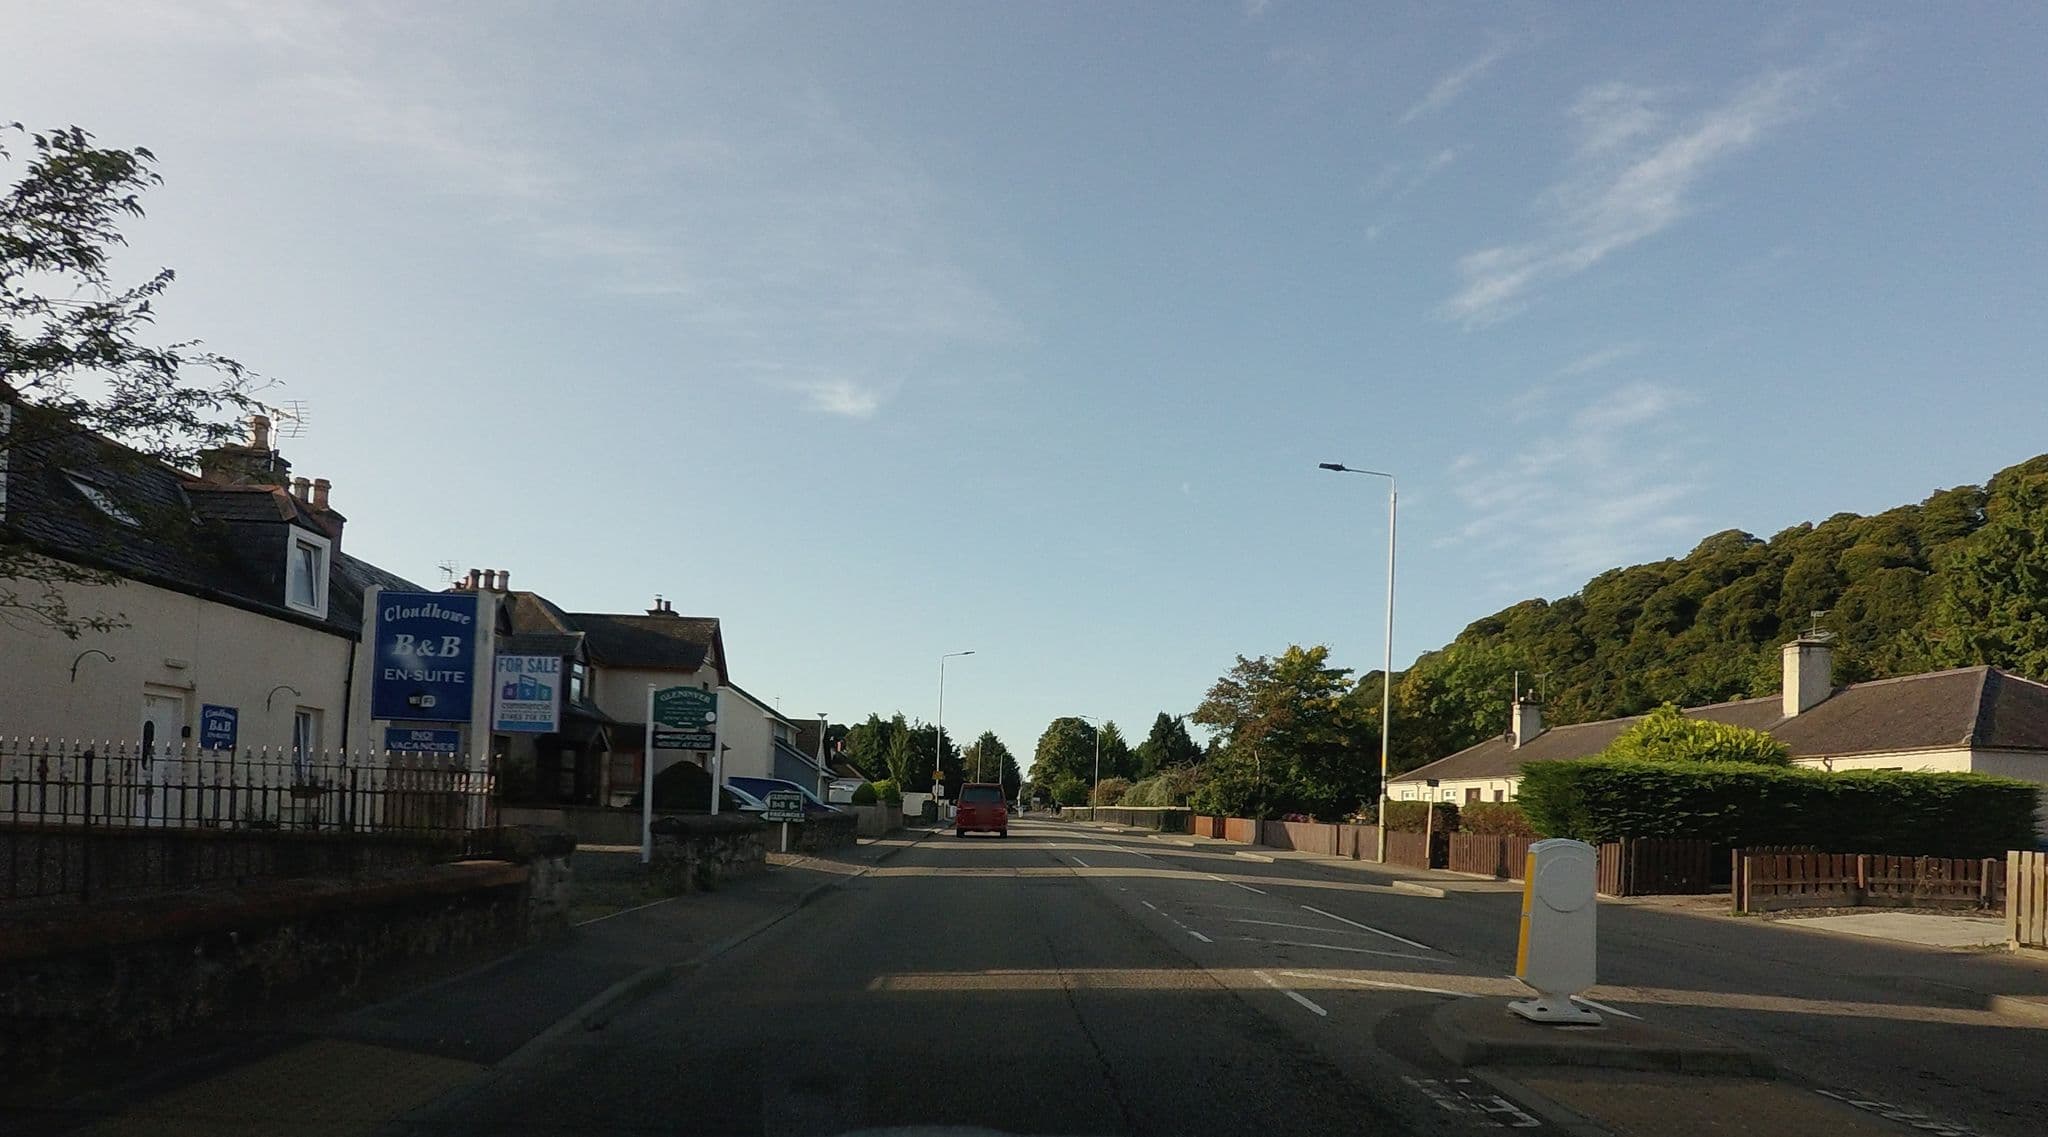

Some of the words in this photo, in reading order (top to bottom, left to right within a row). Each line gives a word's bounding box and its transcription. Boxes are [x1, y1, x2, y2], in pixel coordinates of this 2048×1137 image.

[384, 603, 472, 625] Cloudhowe
[498, 657, 523, 673] FOR
[527, 657, 560, 674] SALE
[384, 668, 466, 684] EN-SUITE
[390, 740, 456, 752] VACANCIES
